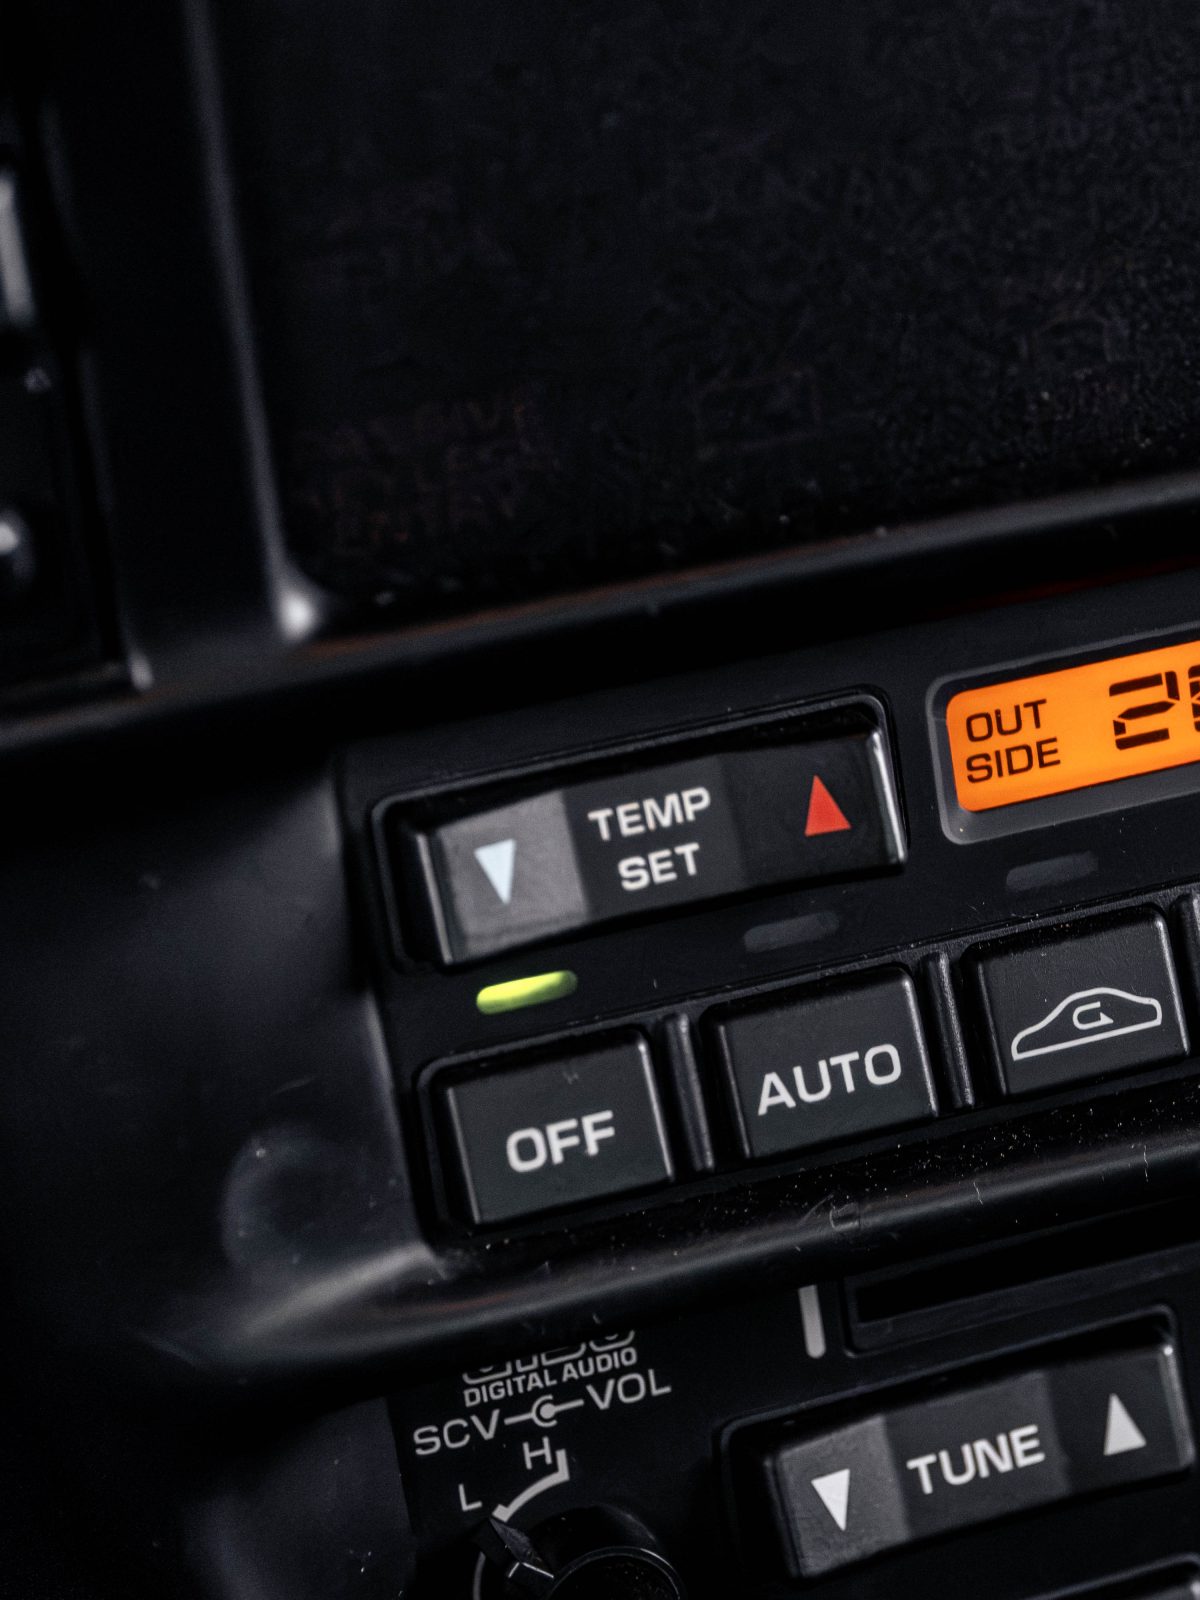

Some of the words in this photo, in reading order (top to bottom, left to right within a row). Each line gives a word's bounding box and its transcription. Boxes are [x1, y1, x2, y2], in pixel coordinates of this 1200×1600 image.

[966, 699, 1047, 742] OUT
[966, 737, 1060, 783] SIDE
[588, 787, 711, 841] TEMP
[618, 844, 701, 891] SET
[757, 1043, 901, 1116] AUTO
[506, 1111, 615, 1173] OFF
[463, 1370, 558, 1408] DIGITAL
[561, 1347, 638, 1382] AUDIO
[413, 1409, 500, 1456] SCV
[586, 1369, 672, 1411] VOL
[522, 1436, 553, 1470] H
[906, 1424, 1046, 1495] TUNE
[458, 1483, 483, 1512] L
